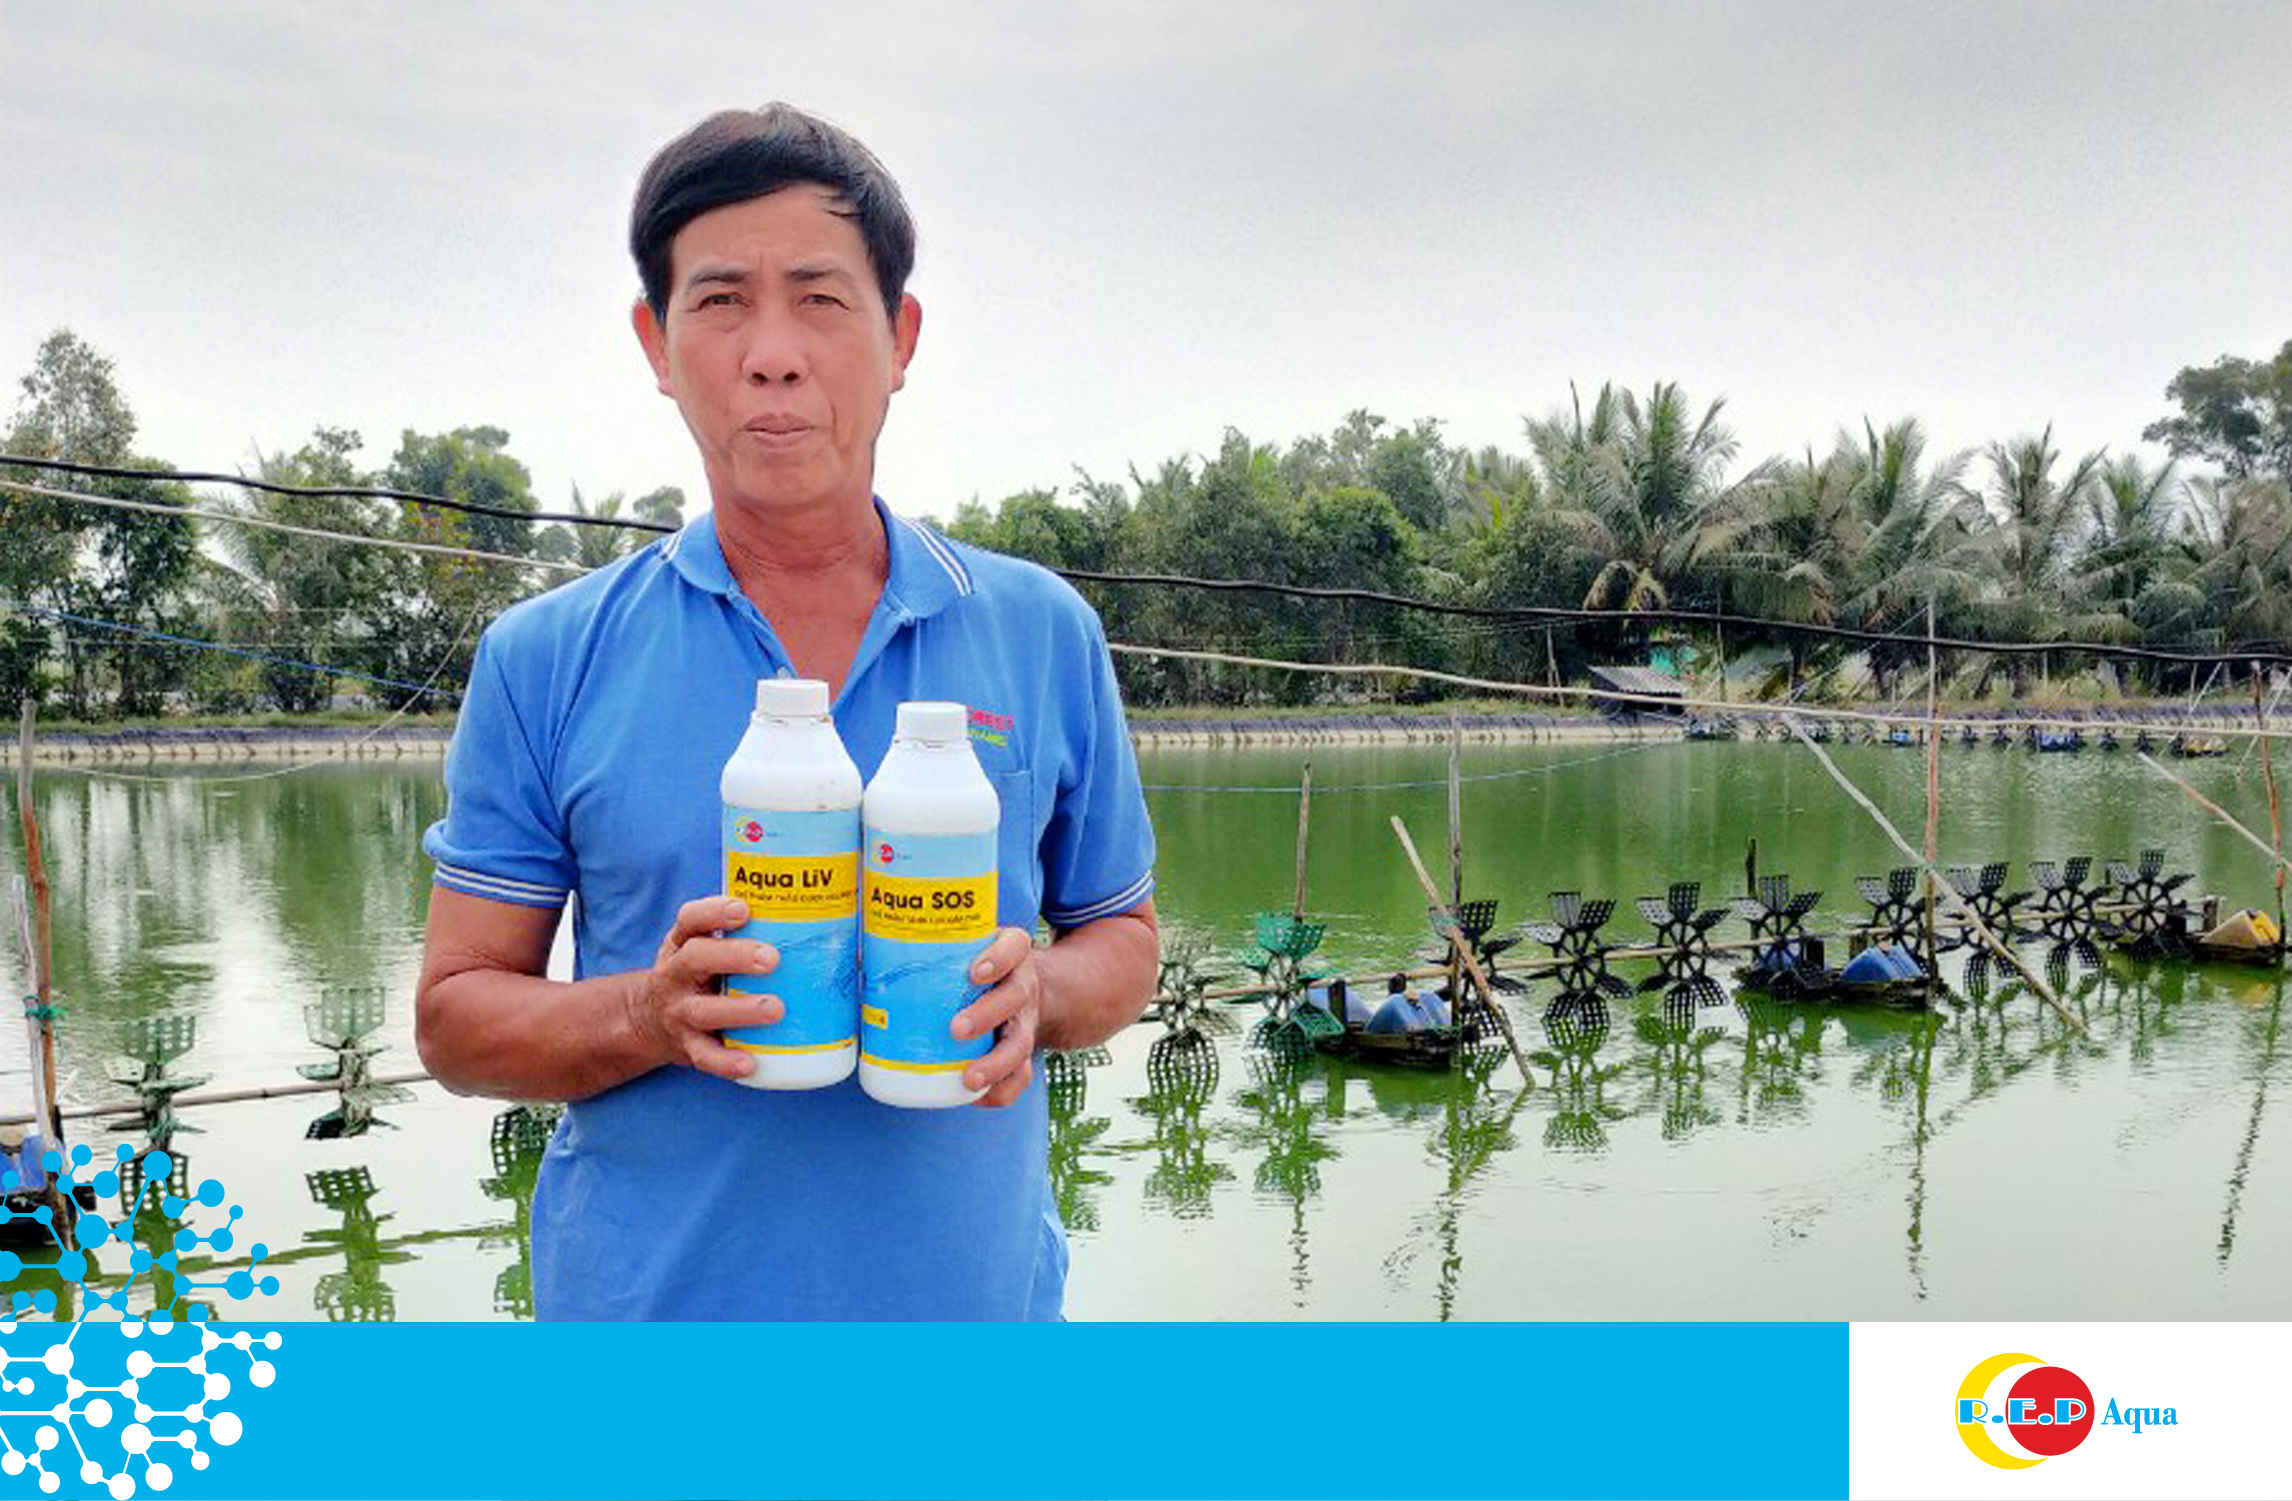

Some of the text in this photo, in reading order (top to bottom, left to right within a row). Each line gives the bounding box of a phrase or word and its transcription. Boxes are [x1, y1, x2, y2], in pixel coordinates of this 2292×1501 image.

[734, 866, 833, 889] Aqua LiV
[871, 886, 924, 910] Aqua
[931, 890, 975, 910] SOS
